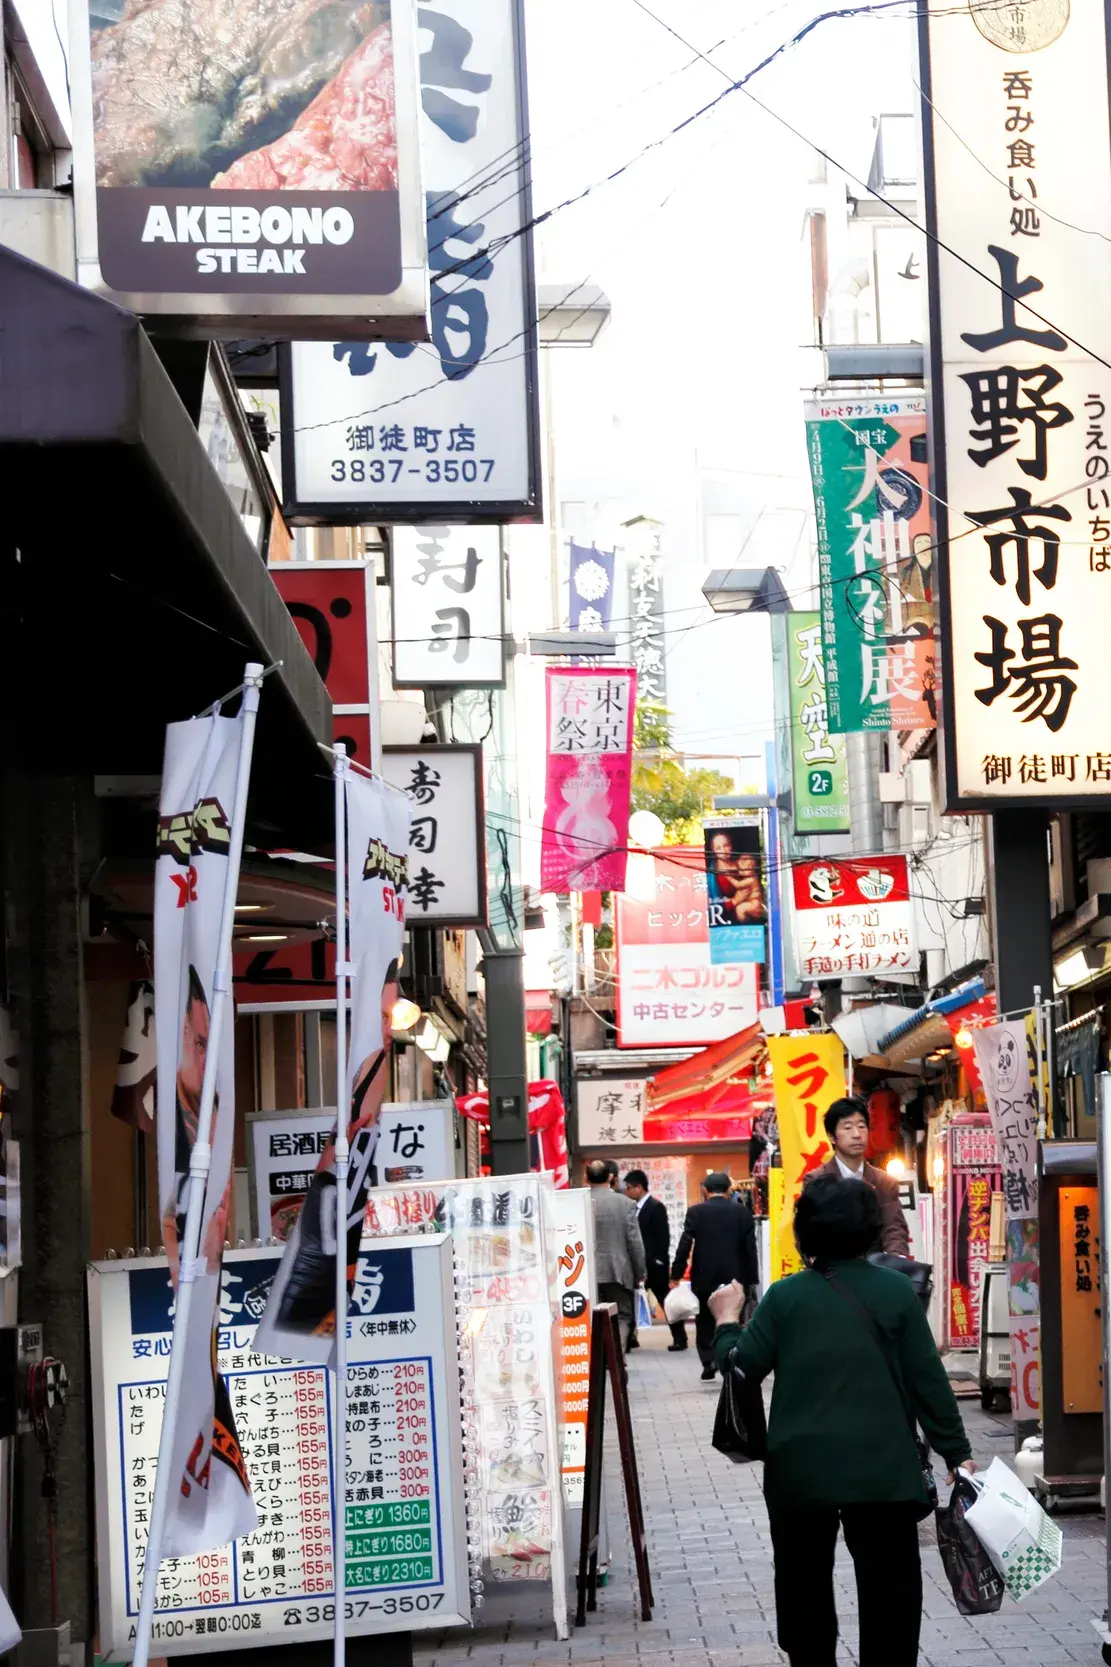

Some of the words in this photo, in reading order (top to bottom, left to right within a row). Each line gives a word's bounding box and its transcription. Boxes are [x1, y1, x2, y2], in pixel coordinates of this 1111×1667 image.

[1001, 69, 1041, 239] 呑み食い処
[141, 205, 355, 244] AKEBONO
[198, 248, 306, 275] STEAK
[347, 425, 476, 452] 御徒町店
[331, 460, 496, 483] 3837-3507
[960, 243, 1080, 733] 上野市場
[1083, 393, 1111, 573] うえのいちば
[841, 447, 923, 706] 大神社展
[555, 679, 589, 751] 春祭
[590, 679, 627, 751] 東京
[811, 773, 829, 792] 2F
[633, 1001, 744, 1021] 中古センター
[1073, 1204, 1093, 1293] 呑み食い処
[562, 1296, 584, 1312] 3F
